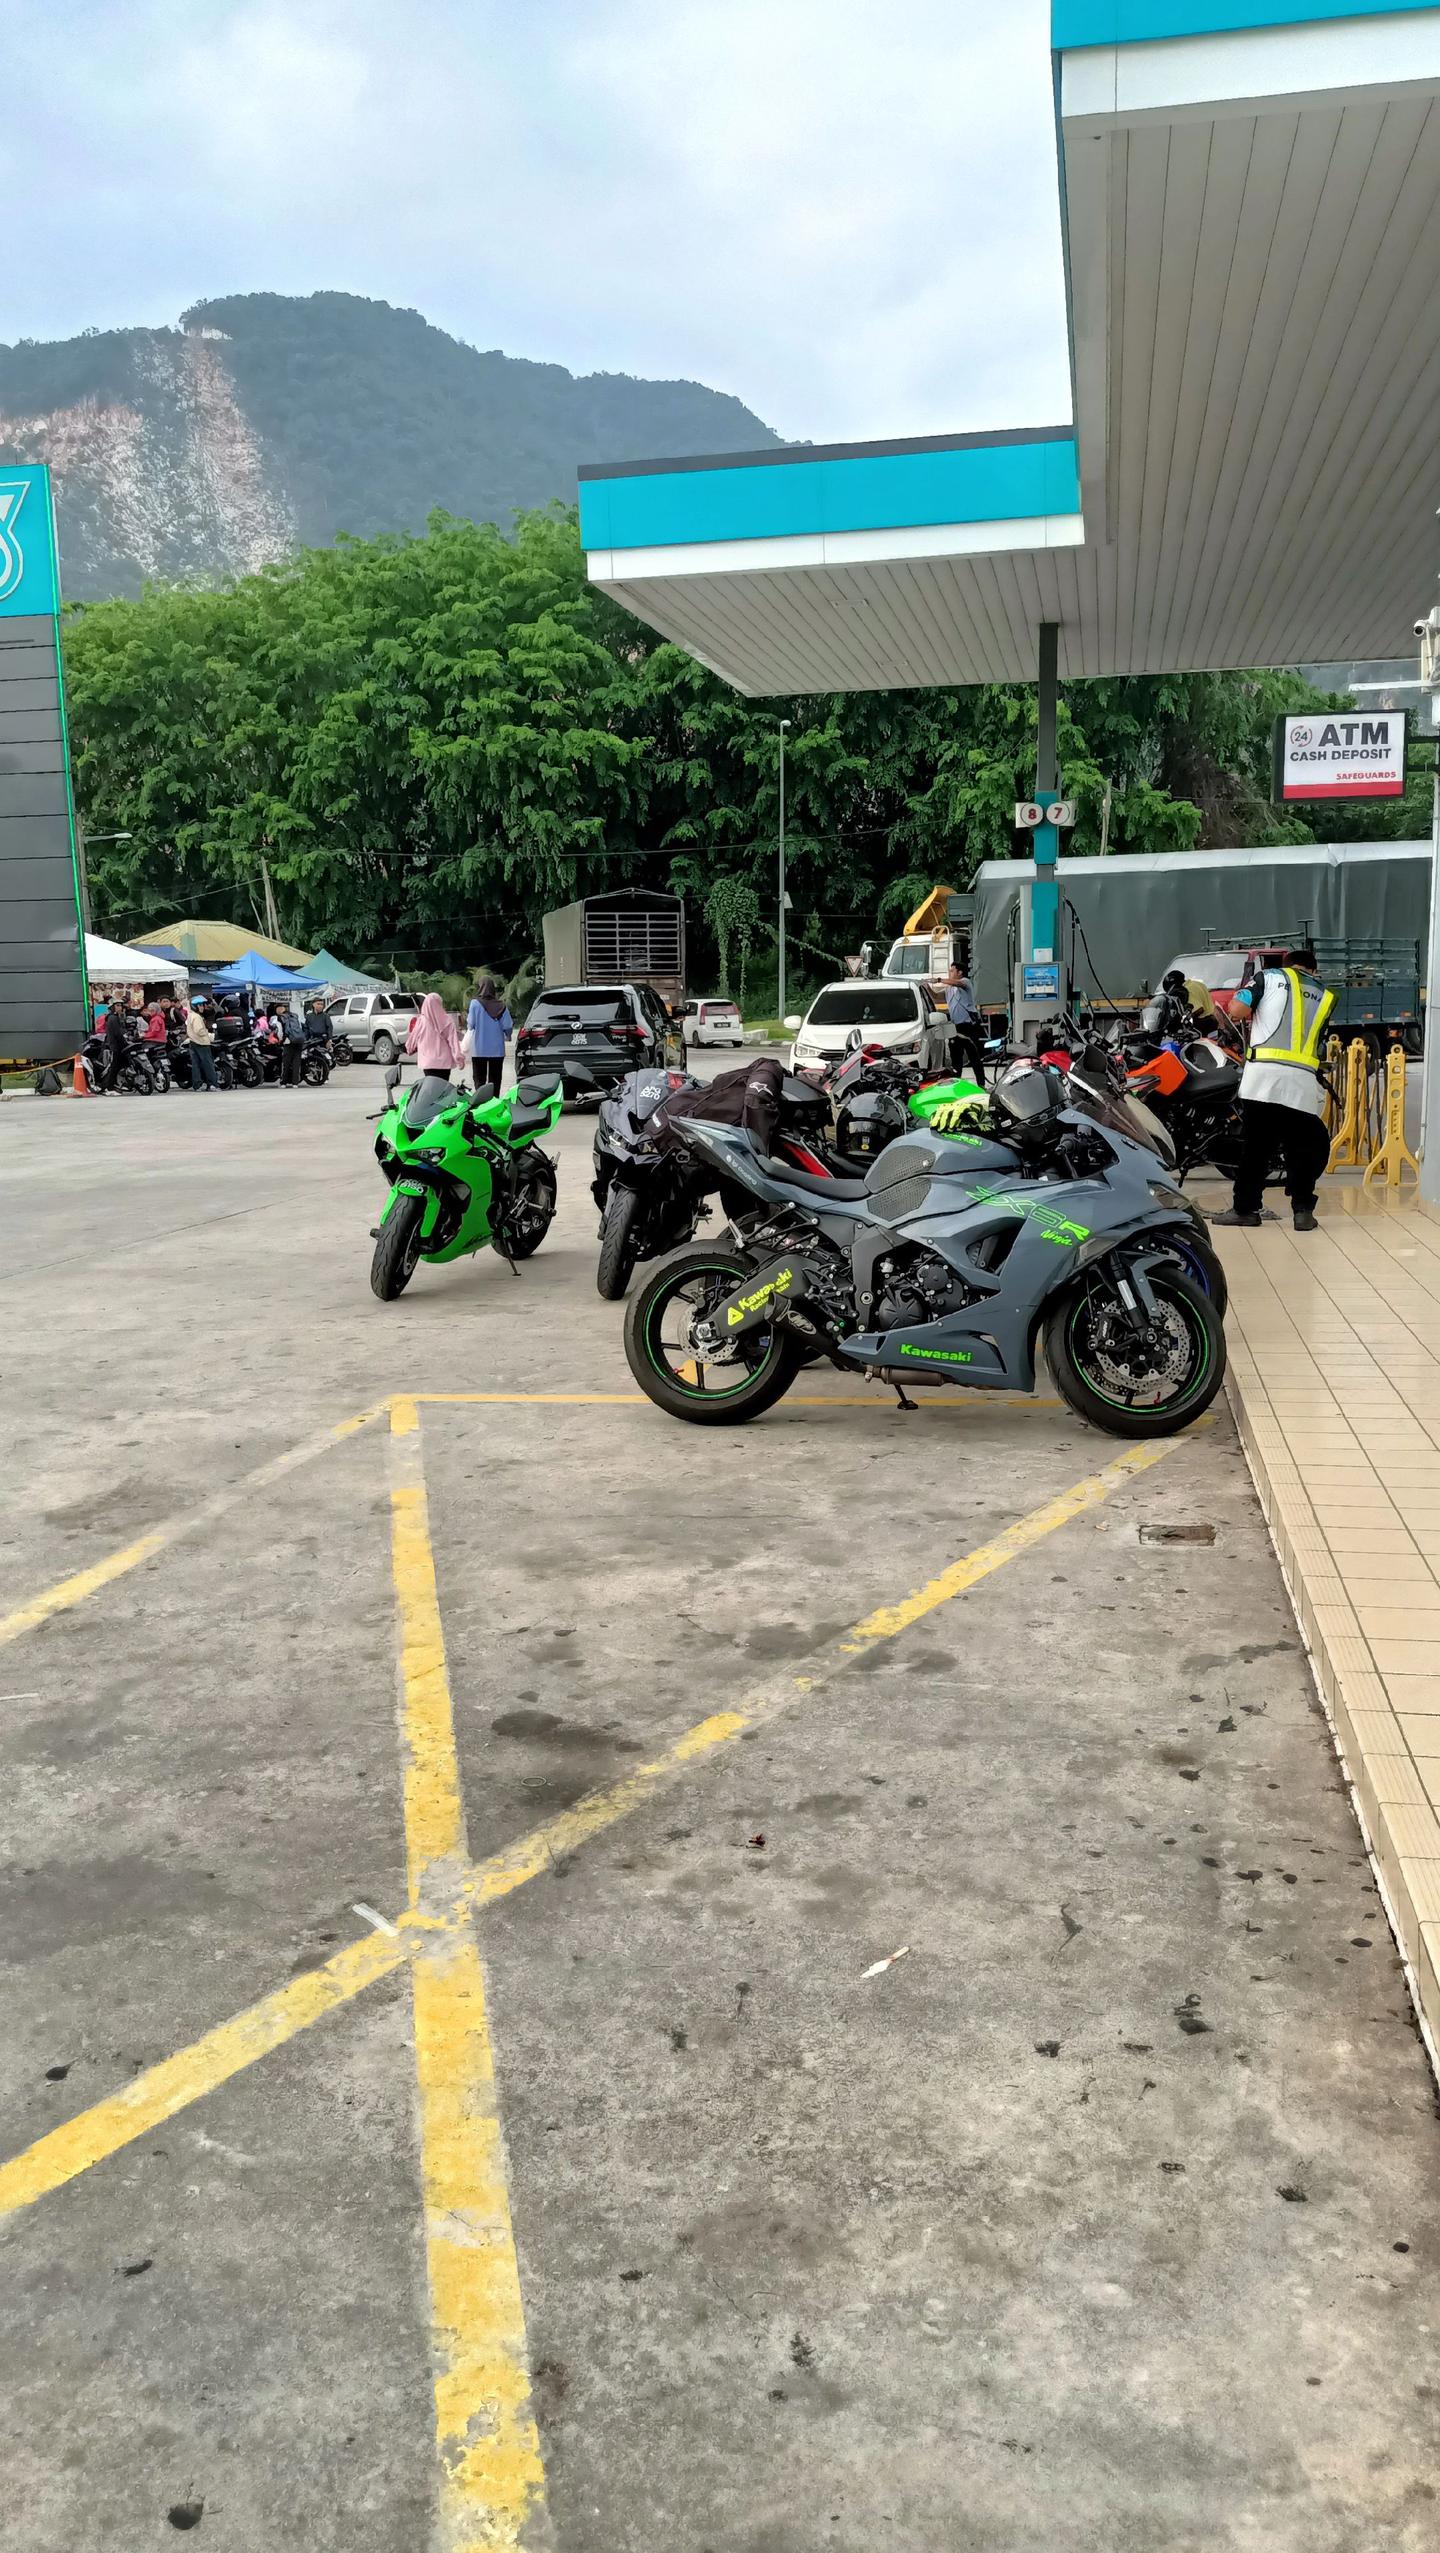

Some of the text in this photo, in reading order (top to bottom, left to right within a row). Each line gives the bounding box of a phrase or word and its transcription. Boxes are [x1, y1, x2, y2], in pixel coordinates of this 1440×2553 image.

[1294, 722, 1389, 747] 24 ATM
[1290, 748, 1391, 762] CASH DEPOSIT
[1336, 771, 1397, 780] SAFEGUARDS
[1028, 807, 1063, 820] 8 7
[900, 1343, 972, 1362] Kawasaki
